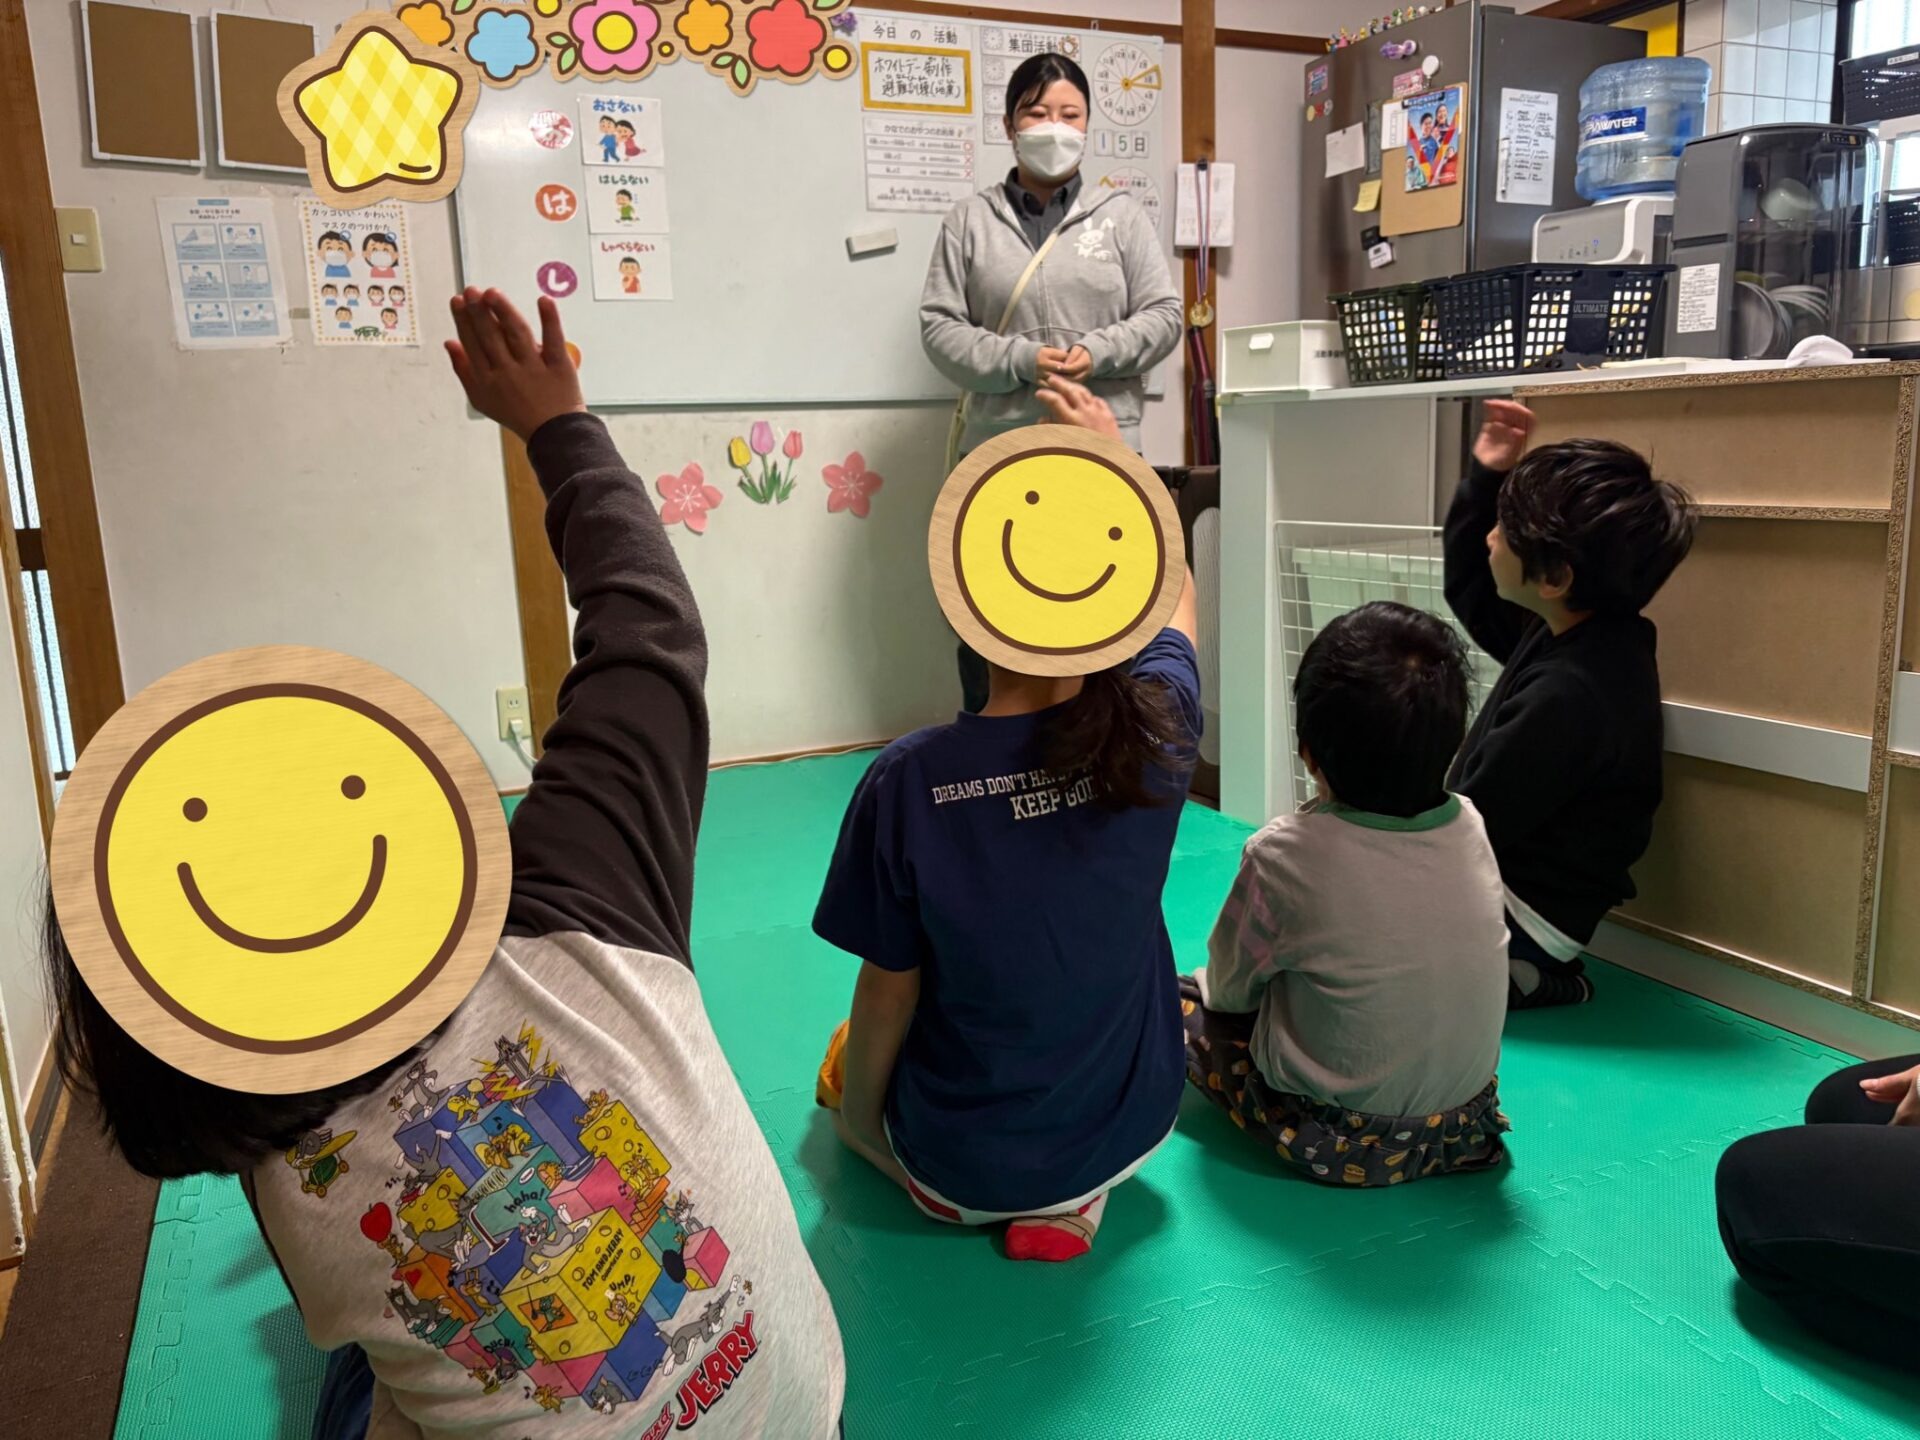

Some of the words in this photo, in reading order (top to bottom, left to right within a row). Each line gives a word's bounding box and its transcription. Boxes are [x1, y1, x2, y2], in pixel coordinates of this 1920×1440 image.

[873, 24, 896, 39] 今日
[910, 29, 921, 40] の
[934, 29, 958, 44] 活動
[593, 98, 644, 113] おさない
[599, 174, 649, 186] はしらない
[543, 190, 573, 216] は
[321, 221, 391, 231] マスクのつけかた
[601, 241, 655, 252] しゃべらない
[547, 267, 570, 292] し
[932, 779, 984, 804] DREAMS
[985, 772, 1028, 796] DON'T
[1010, 788, 1061, 820] KEEP
[503, 1187, 545, 1213] haha!
[582, 1268, 599, 1291] TOM
[605, 1228, 624, 1258] JERRY
[676, 1310, 758, 1431] JERRY
